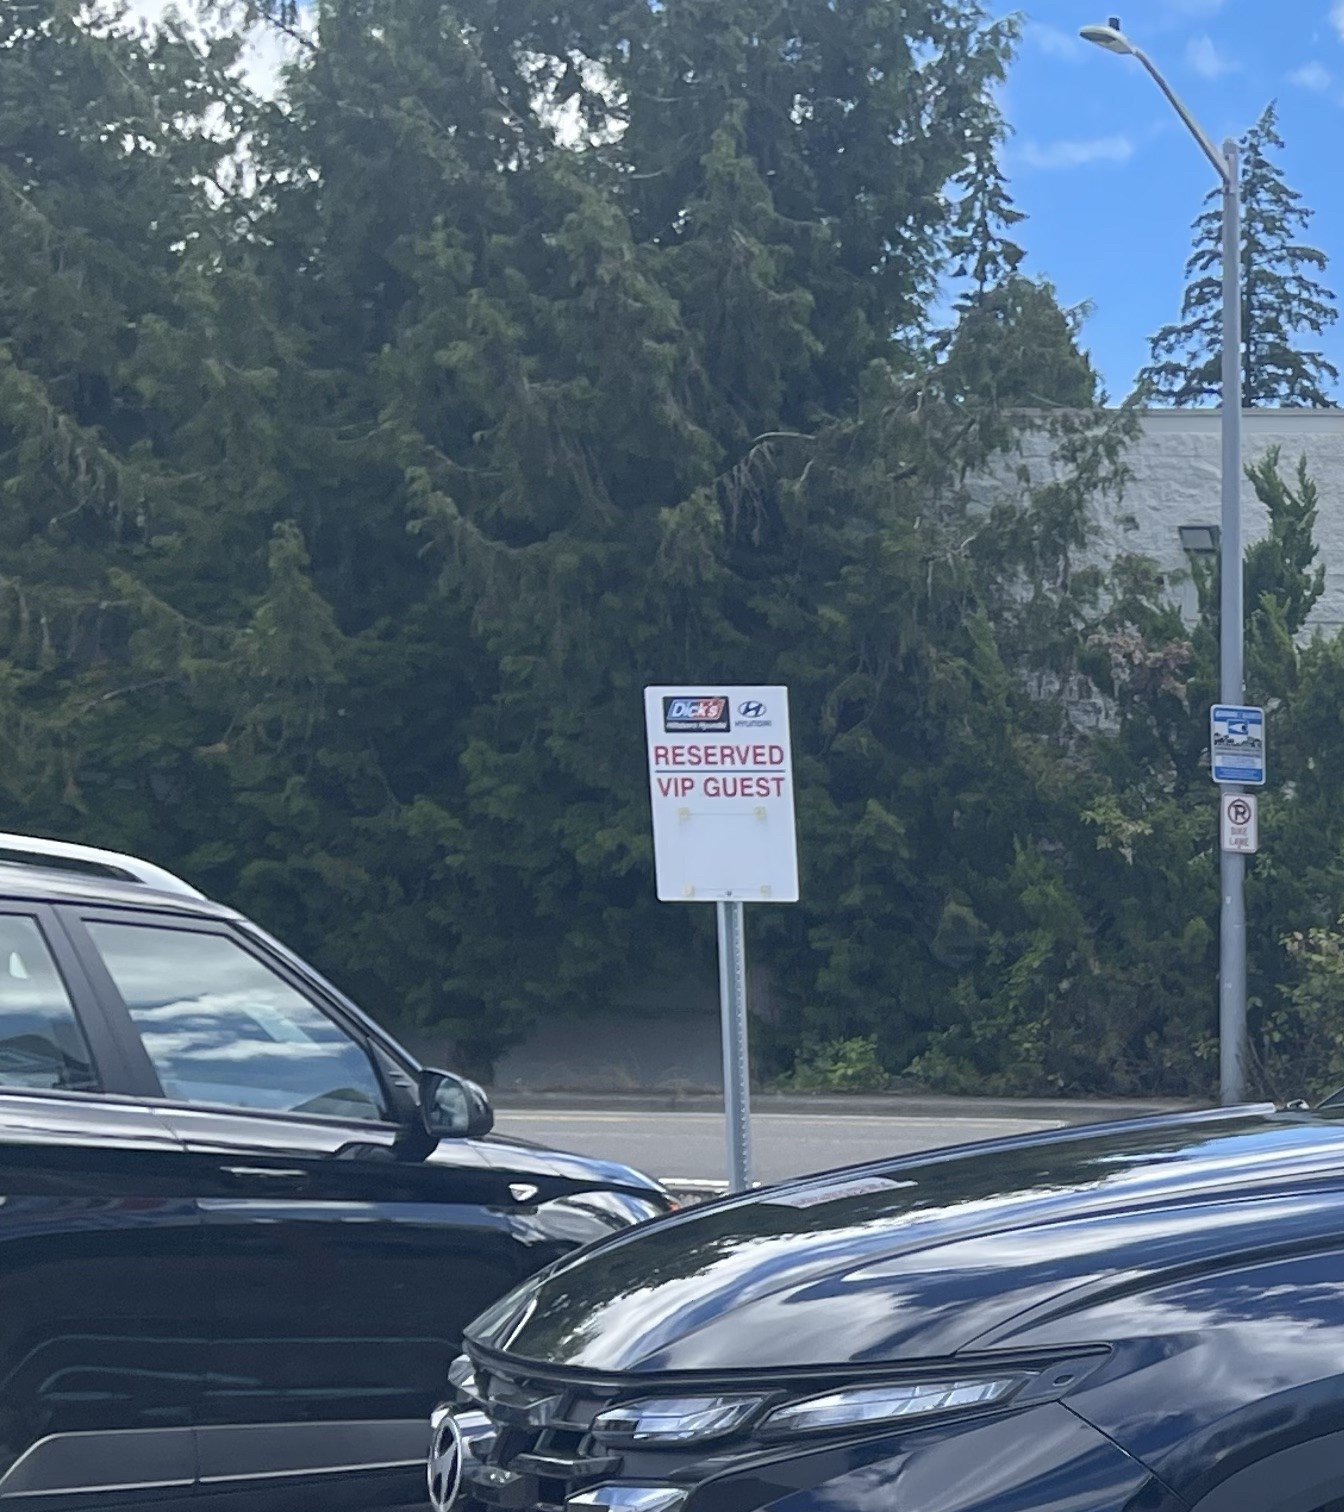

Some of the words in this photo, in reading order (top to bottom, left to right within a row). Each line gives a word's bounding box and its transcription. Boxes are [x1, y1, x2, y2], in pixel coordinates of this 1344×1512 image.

[654, 744, 784, 767] RESERVED
[656, 777, 695, 798] VIP
[702, 776, 786, 798] GUEST
